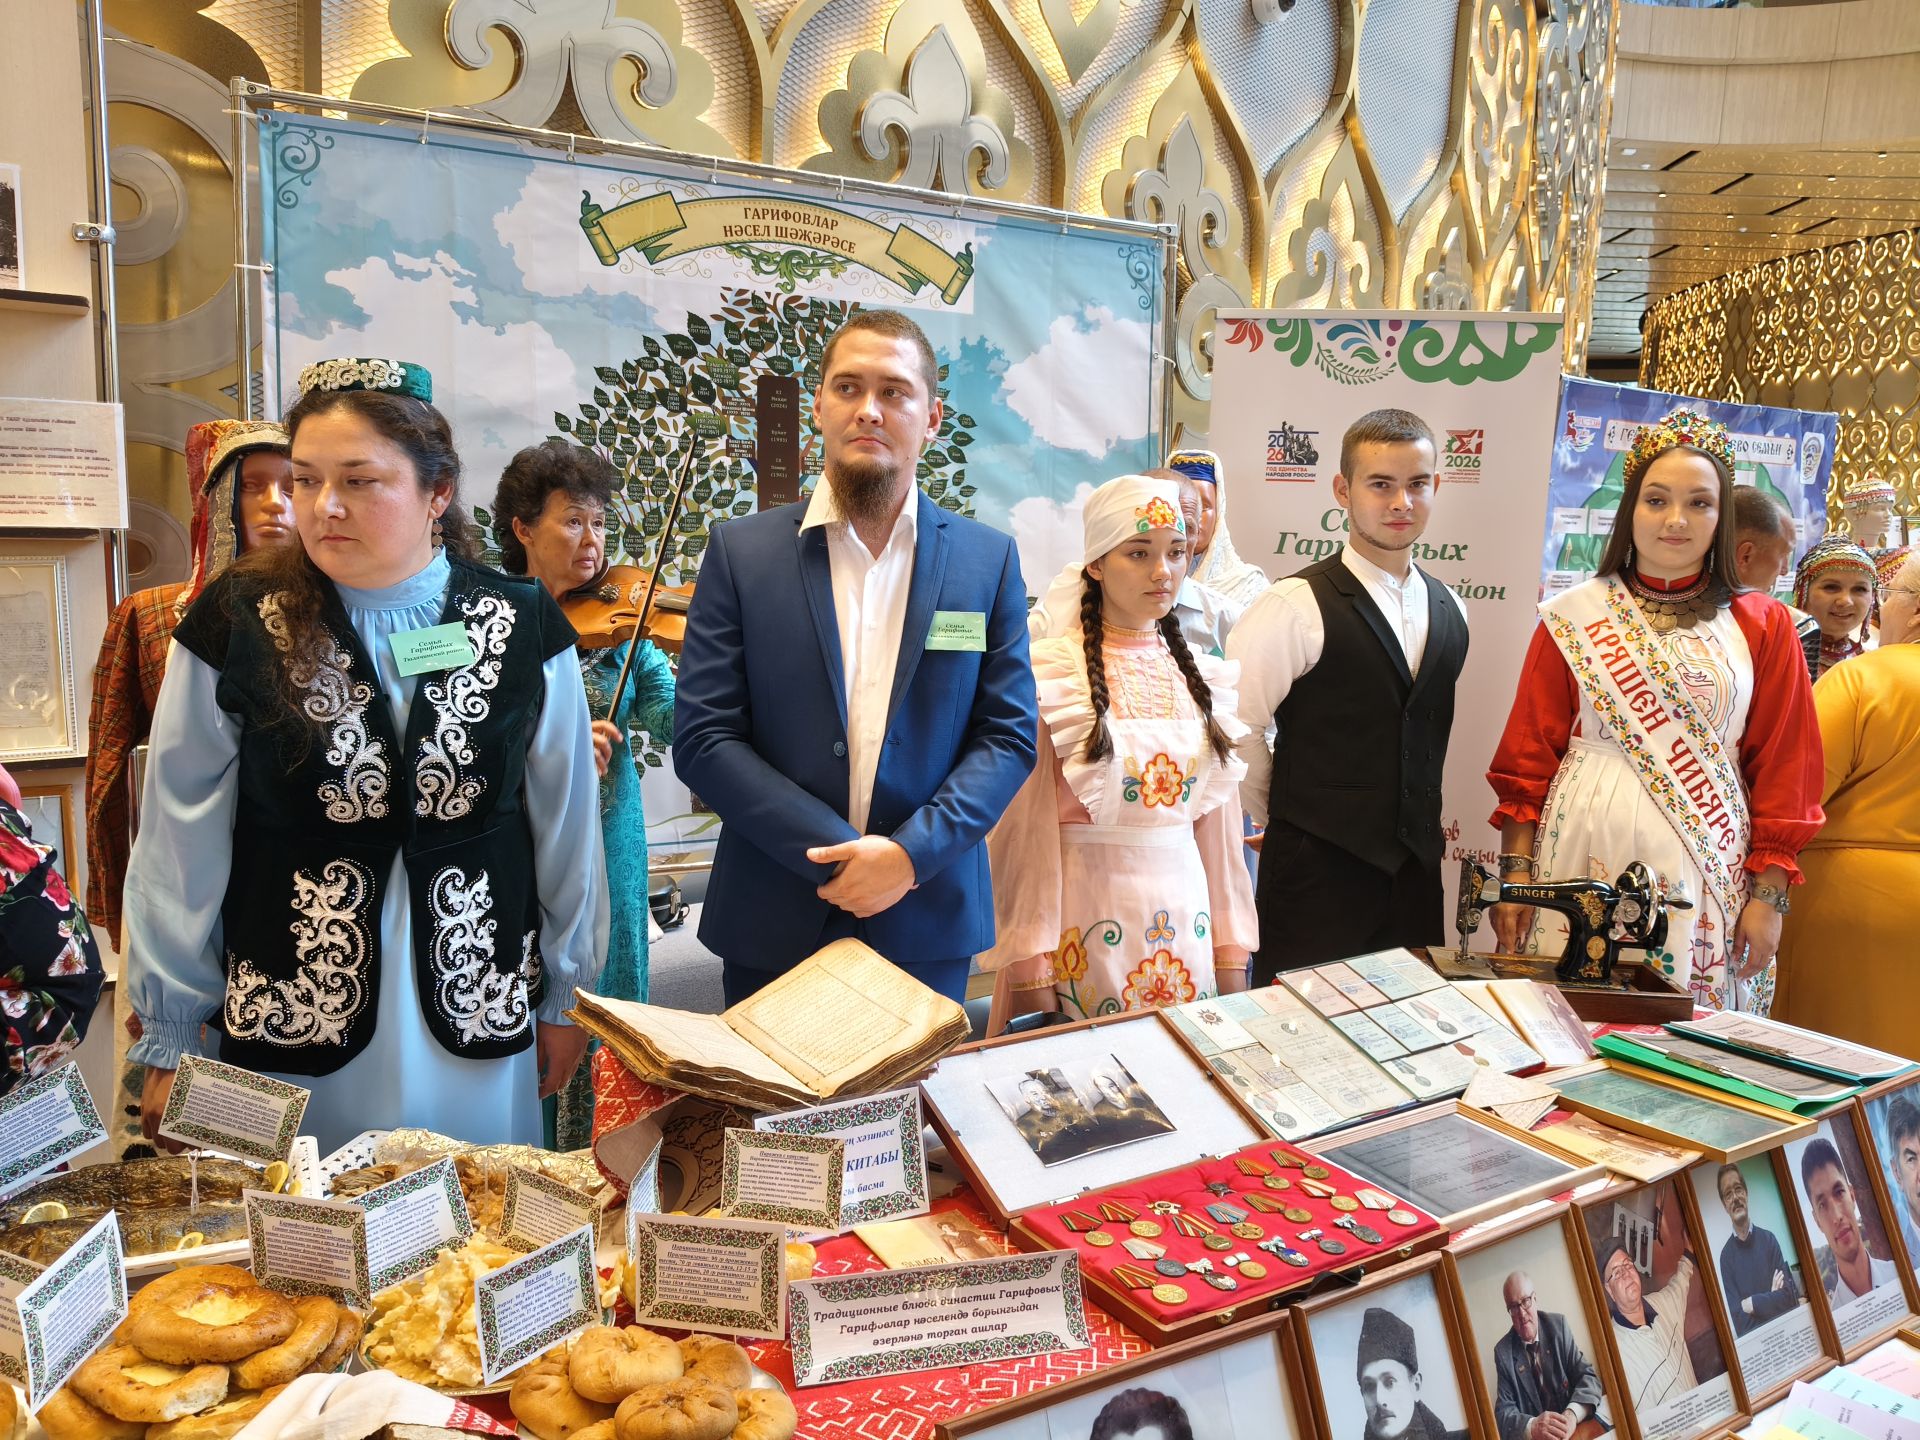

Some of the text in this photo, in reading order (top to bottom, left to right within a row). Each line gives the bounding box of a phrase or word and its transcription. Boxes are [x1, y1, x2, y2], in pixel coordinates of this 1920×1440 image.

[744, 207, 838, 230] ГАРИФОВЛАР
[723, 225, 856, 254] НӘСЕЛ ШӘҖӘРӘСЕ
[1267, 448, 1285, 461] 26
[1752, 441, 1781, 456] СЕМЬИ
[1445, 455, 1481, 468] 2026
[1511, 887, 1556, 899] SINGER
[856, 1129, 895, 1145] хәзинәсе
[846, 1149, 899, 1172] КИТАБЫ
[857, 1180, 885, 1194] басма
[814, 1284, 1061, 1322] Традиционные блюда династии Гарифовых
[840, 1302, 1039, 1335] Гарифовлар нәселендә борынгыдан
[872, 1321, 1008, 1347] әзерләнә торган ашлар
